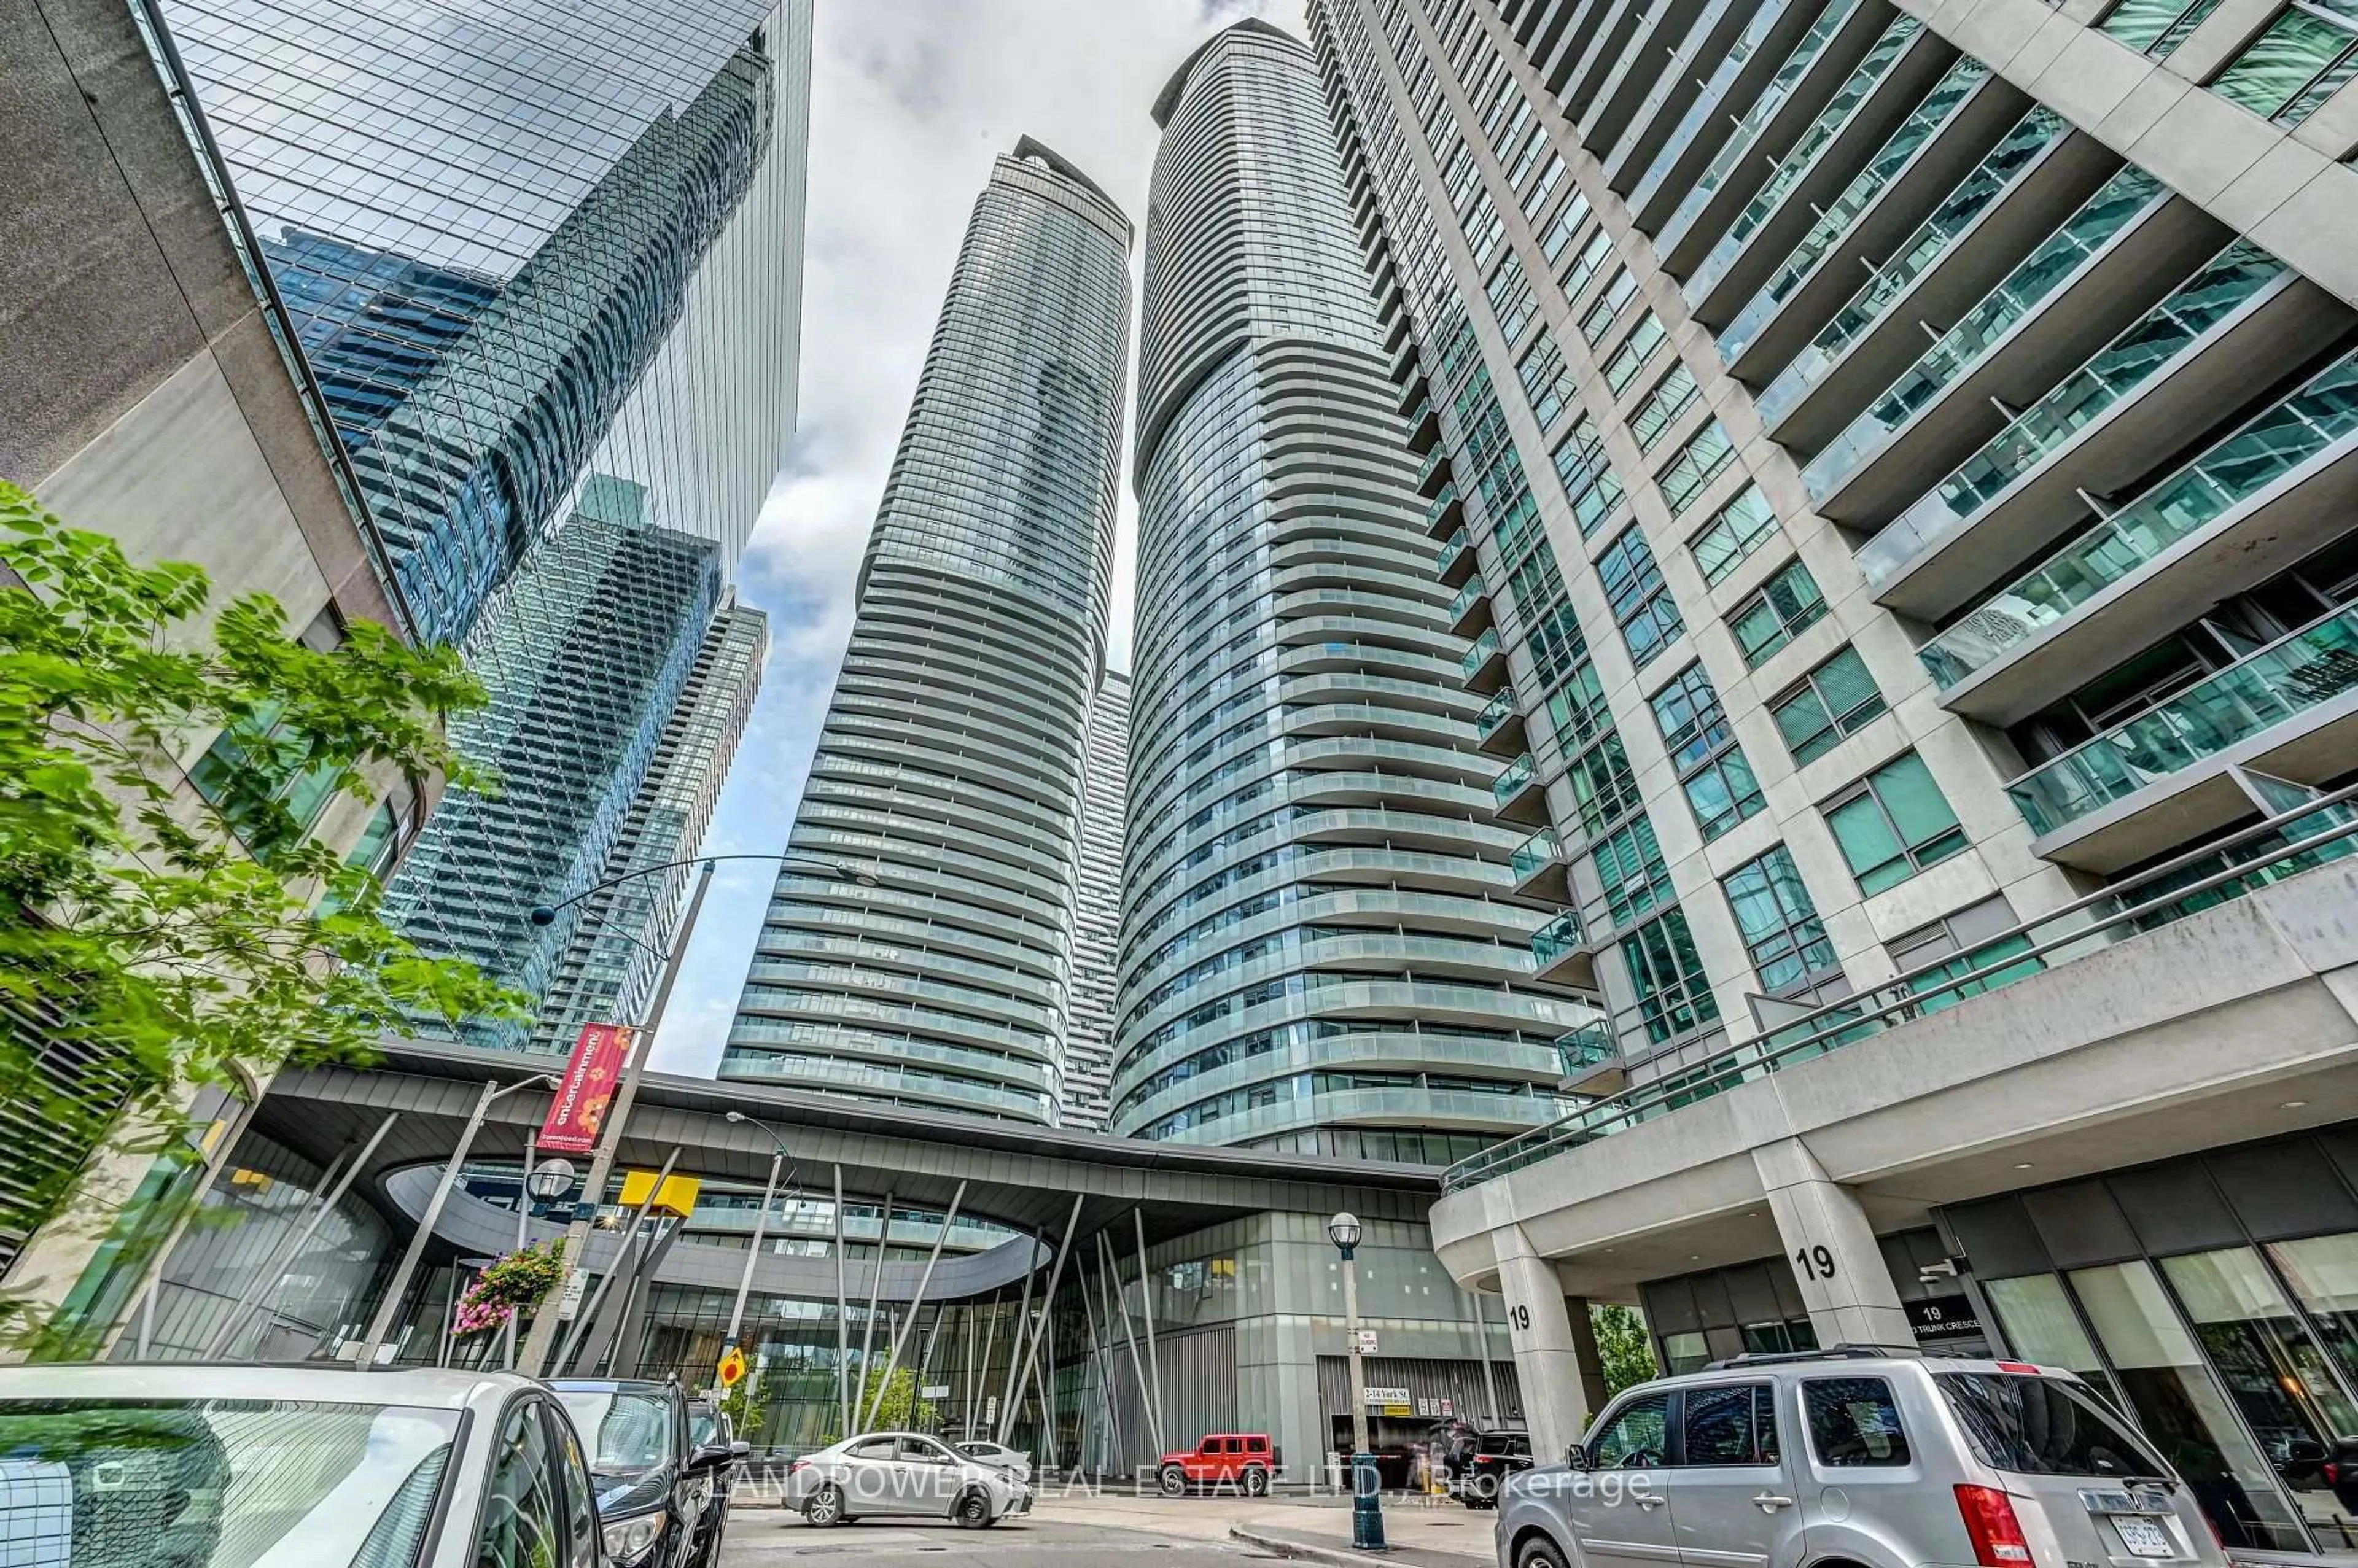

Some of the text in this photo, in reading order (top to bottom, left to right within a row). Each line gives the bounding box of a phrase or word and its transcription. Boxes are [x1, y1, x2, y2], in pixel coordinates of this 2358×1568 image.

[557, 1031, 601, 1126] entertainment
[1796, 1244, 1835, 1281] 19
[1510, 1305, 1530, 1331] 19
[1923, 1306, 1941, 1321] 19
[1917, 1324, 1945, 1333] TRUNK
